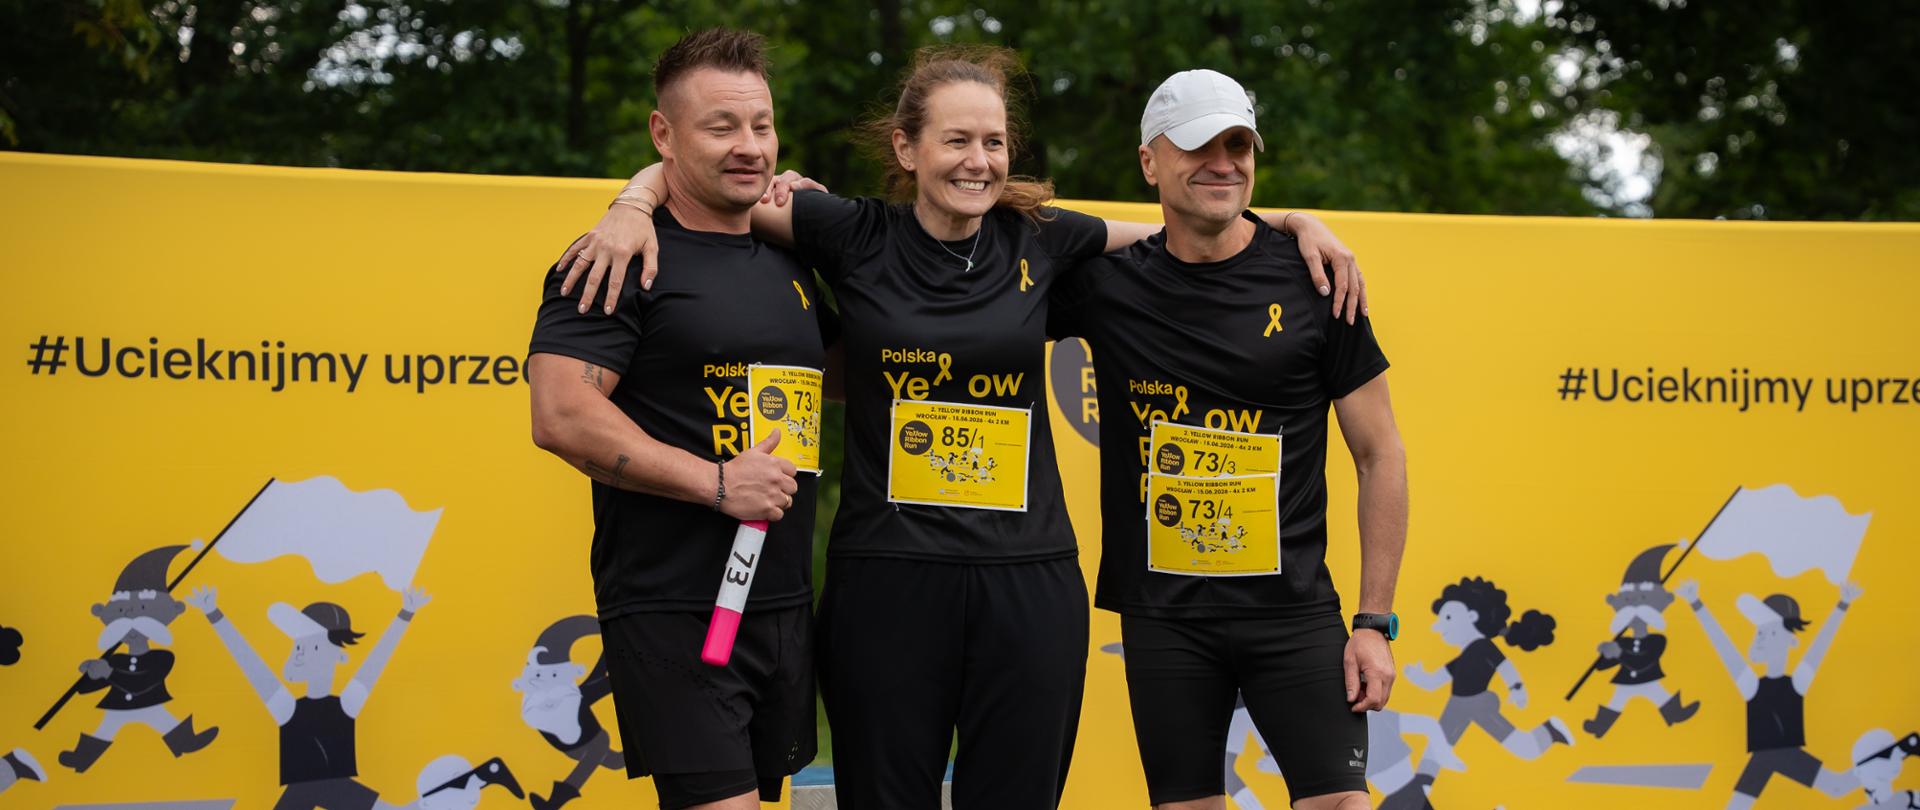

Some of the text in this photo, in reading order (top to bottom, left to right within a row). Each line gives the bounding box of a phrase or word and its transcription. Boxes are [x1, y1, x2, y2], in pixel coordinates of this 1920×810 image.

[27, 335, 368, 393] #Ucieknijmy
[384, 353, 530, 394] uprze
[881, 348, 936, 363] Polska
[1129, 379, 1173, 395] Polska
[1558, 367, 1813, 412] #Ucieknijmy
[961, 408, 984, 416] RIBBON
[941, 426, 984, 449] 85/1
[1190, 431, 1212, 439] YELLOW
[1193, 450, 1236, 475] 73/3
[1188, 499, 1233, 519] 73/4
[726, 550, 756, 586] 73
